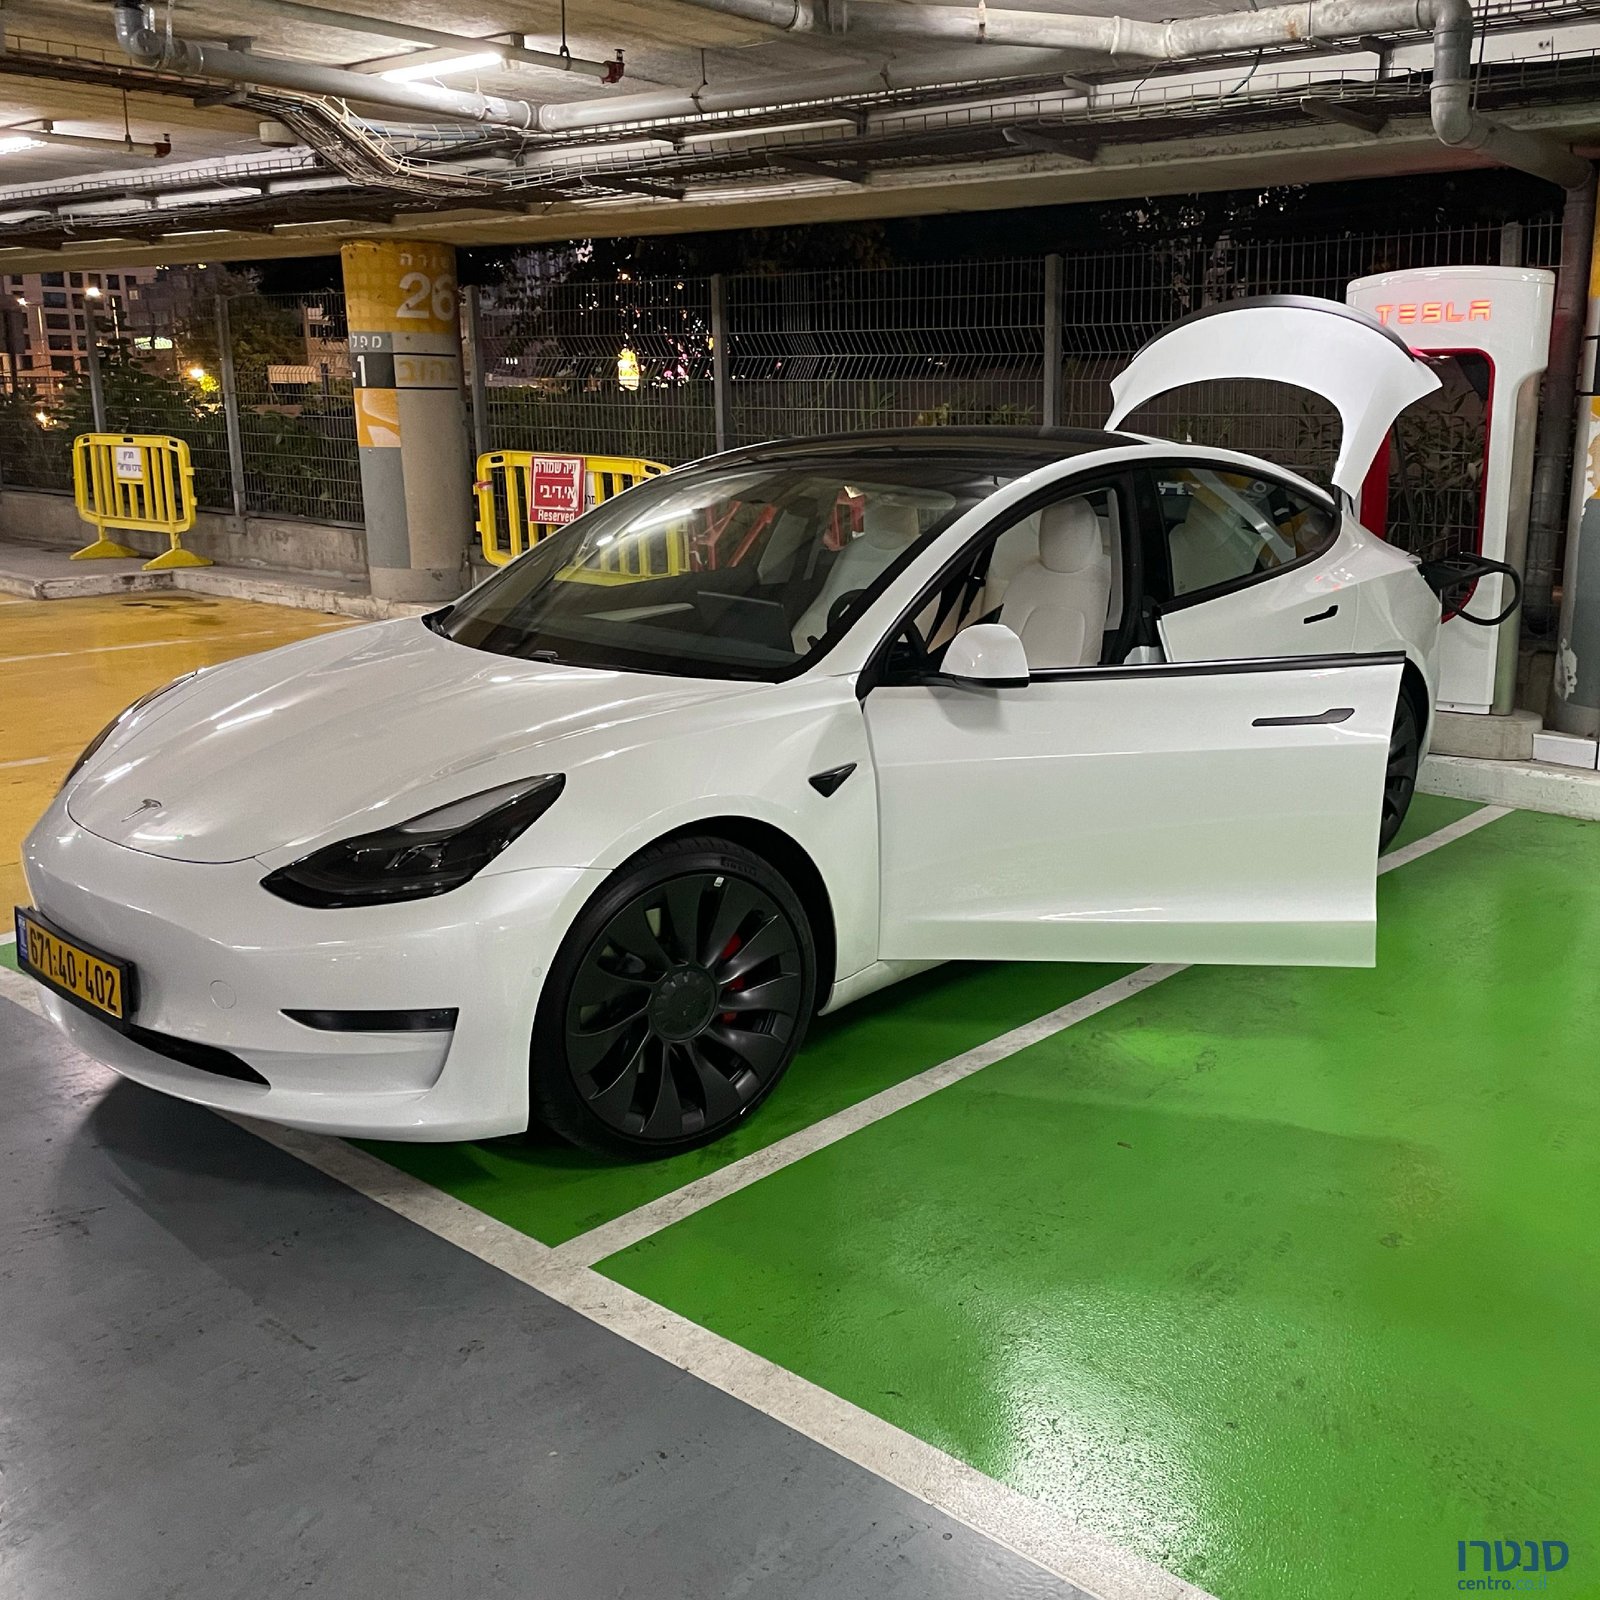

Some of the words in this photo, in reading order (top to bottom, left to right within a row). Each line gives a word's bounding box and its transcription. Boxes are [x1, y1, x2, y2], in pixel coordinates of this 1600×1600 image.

[396, 272, 454, 321] 26
[1376, 299, 1492, 326] TESLA
[350, 332, 382, 349] מפל
[535, 462, 562, 474] שמורה
[563, 463, 576, 474] ניה
[537, 509, 575, 523] Reserved
